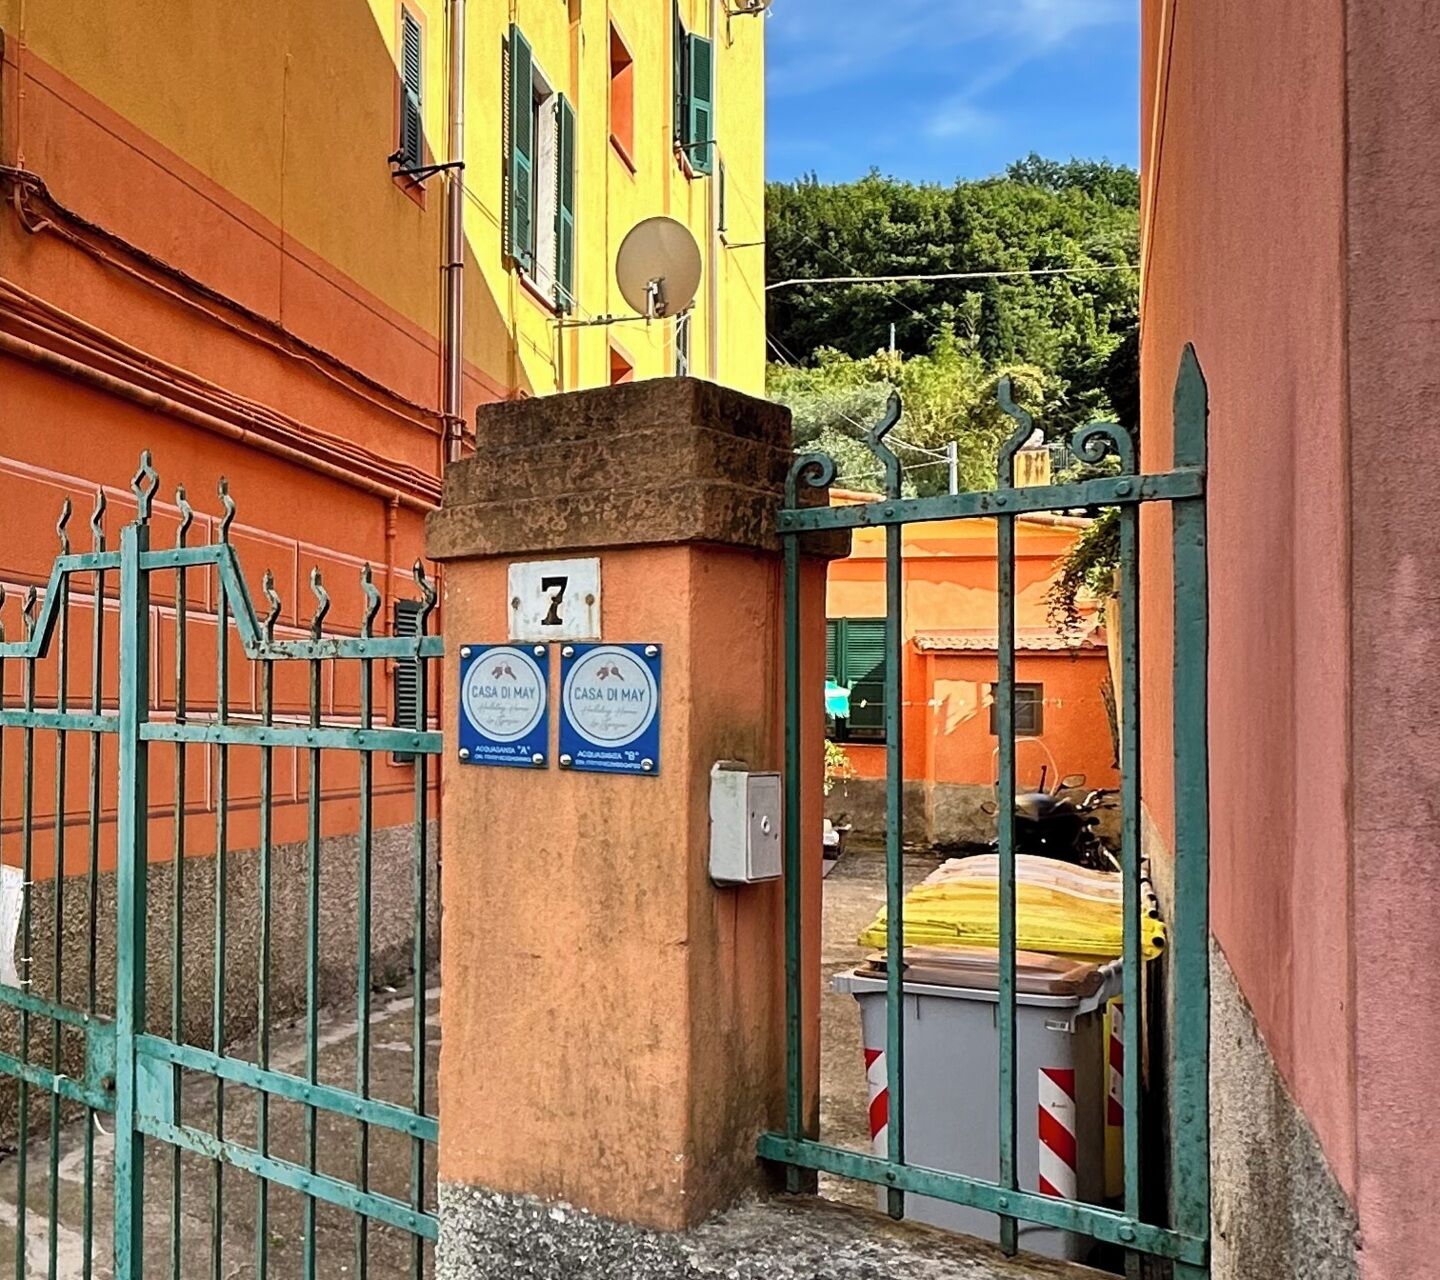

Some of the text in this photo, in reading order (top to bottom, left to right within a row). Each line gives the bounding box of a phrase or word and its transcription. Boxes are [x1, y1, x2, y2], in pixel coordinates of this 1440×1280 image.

[540, 576, 569, 626] 7
[472, 685, 535, 699] CASA DI MAY
[574, 687, 645, 702] CASA DI MAY
